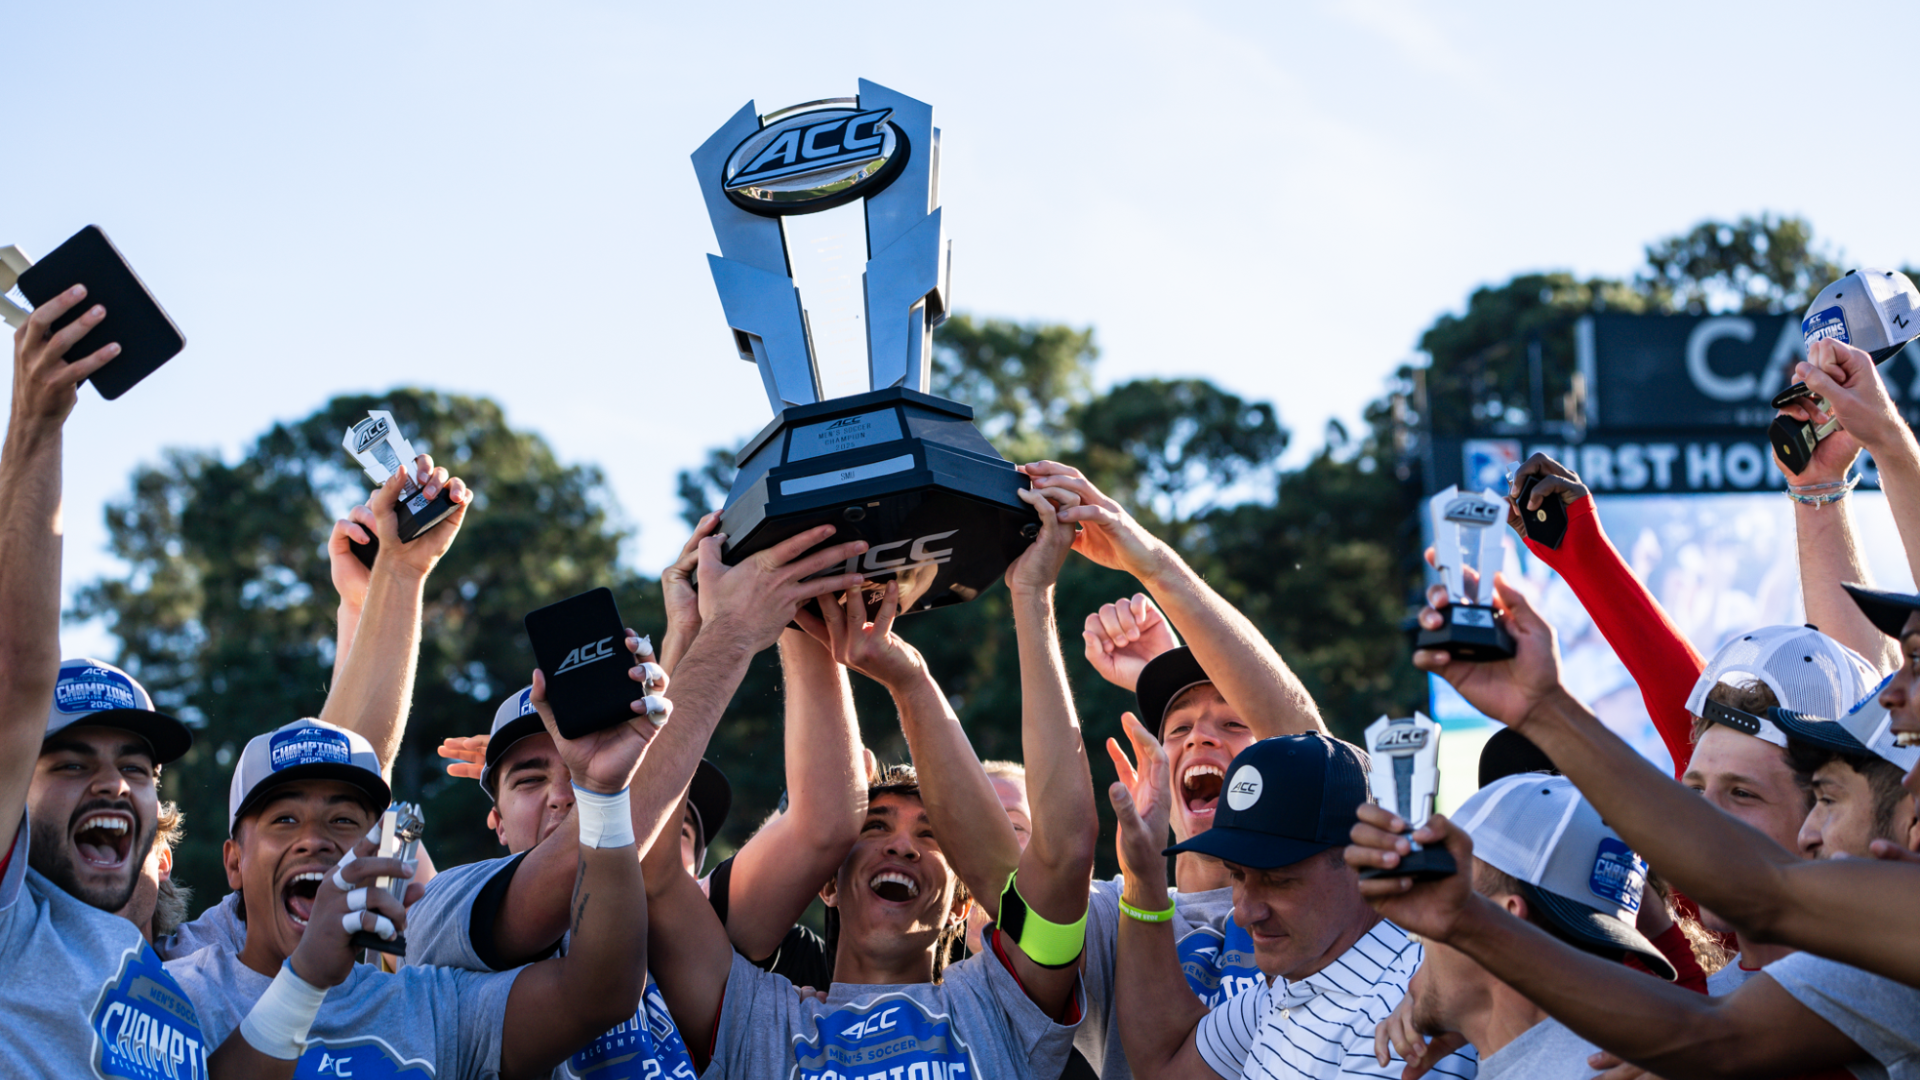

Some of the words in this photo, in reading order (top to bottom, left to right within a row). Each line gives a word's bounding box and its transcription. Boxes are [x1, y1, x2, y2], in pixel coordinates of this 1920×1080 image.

[740, 108, 892, 175] ACC
[818, 429, 840, 440] MEN'S
[843, 423, 872, 434] SOCCER
[826, 416, 863, 431] ACC
[359, 418, 388, 448] ACC
[825, 432, 866, 446] CHAMPION
[835, 442, 856, 451] 2025
[840, 471, 855, 480] SMU
[1454, 503, 1498, 518] ACC
[555, 636, 614, 674] ACC
[80, 667, 109, 677] ACC
[56, 683, 134, 707] CHAMPIONS
[90, 701, 114, 710] 2025
[296, 728, 323, 737] ACC
[1384, 730, 1424, 745] ACC
[272, 741, 349, 761] CHAMPIONS
[300, 757, 323, 765] 2025
[1231, 782, 1258, 794] ACC
[149, 987, 175, 1011] MEN'S
[176, 1002, 200, 1027] SOCC
[839, 1007, 901, 1040] ACC
[101, 1001, 208, 1080] CHAMPI
[580, 1033, 647, 1061] ACCOMPL
[829, 1048, 863, 1064] MEN'S
[868, 1039, 917, 1061] SOCCER
[317, 1053, 352, 1078] AC
